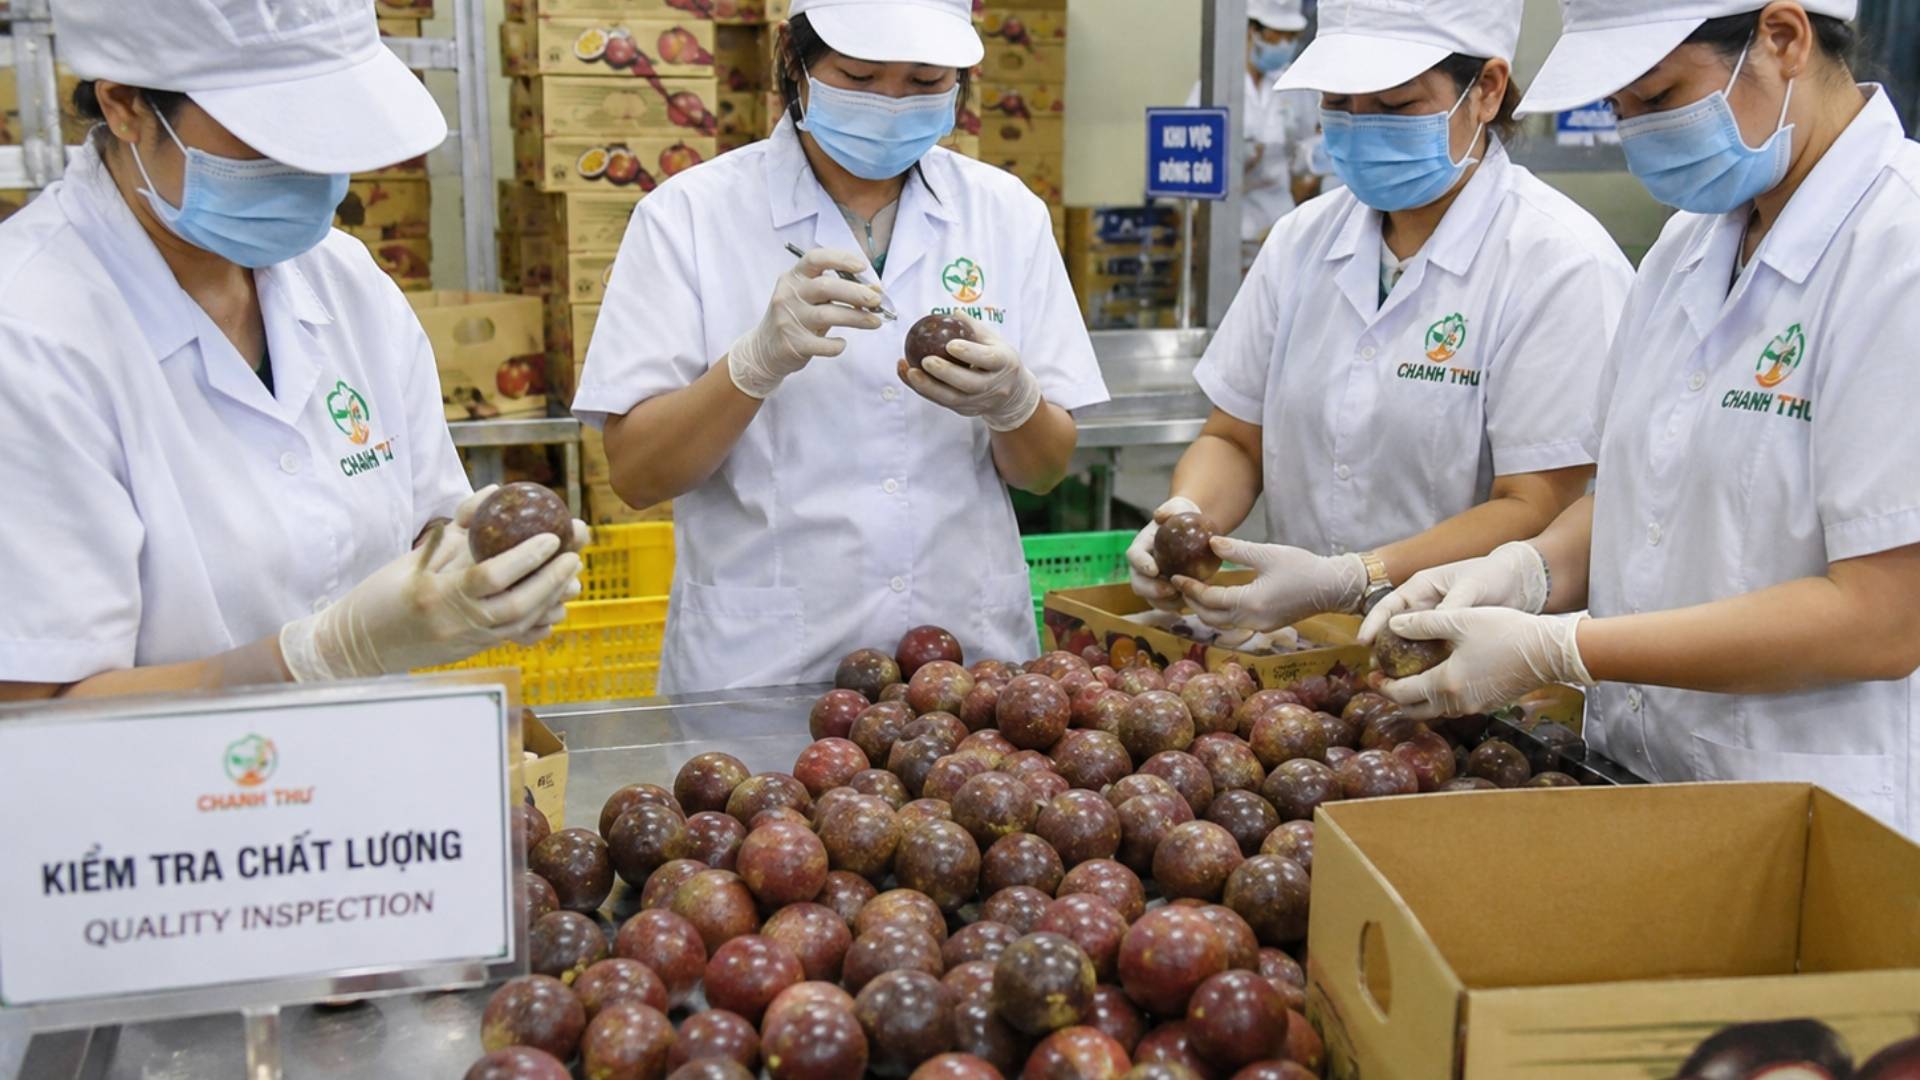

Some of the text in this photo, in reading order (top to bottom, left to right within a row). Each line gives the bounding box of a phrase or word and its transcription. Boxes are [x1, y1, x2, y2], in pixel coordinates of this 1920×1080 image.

[1396, 362, 1447, 382] CHANH
[1721, 389, 1773, 412] CHANH
[196, 791, 267, 813] CHANH
[42, 829, 462, 896] KIỂM TRA CHẤT LƯỢNG
[83, 889, 435, 948] QUALITY INSPECTION
